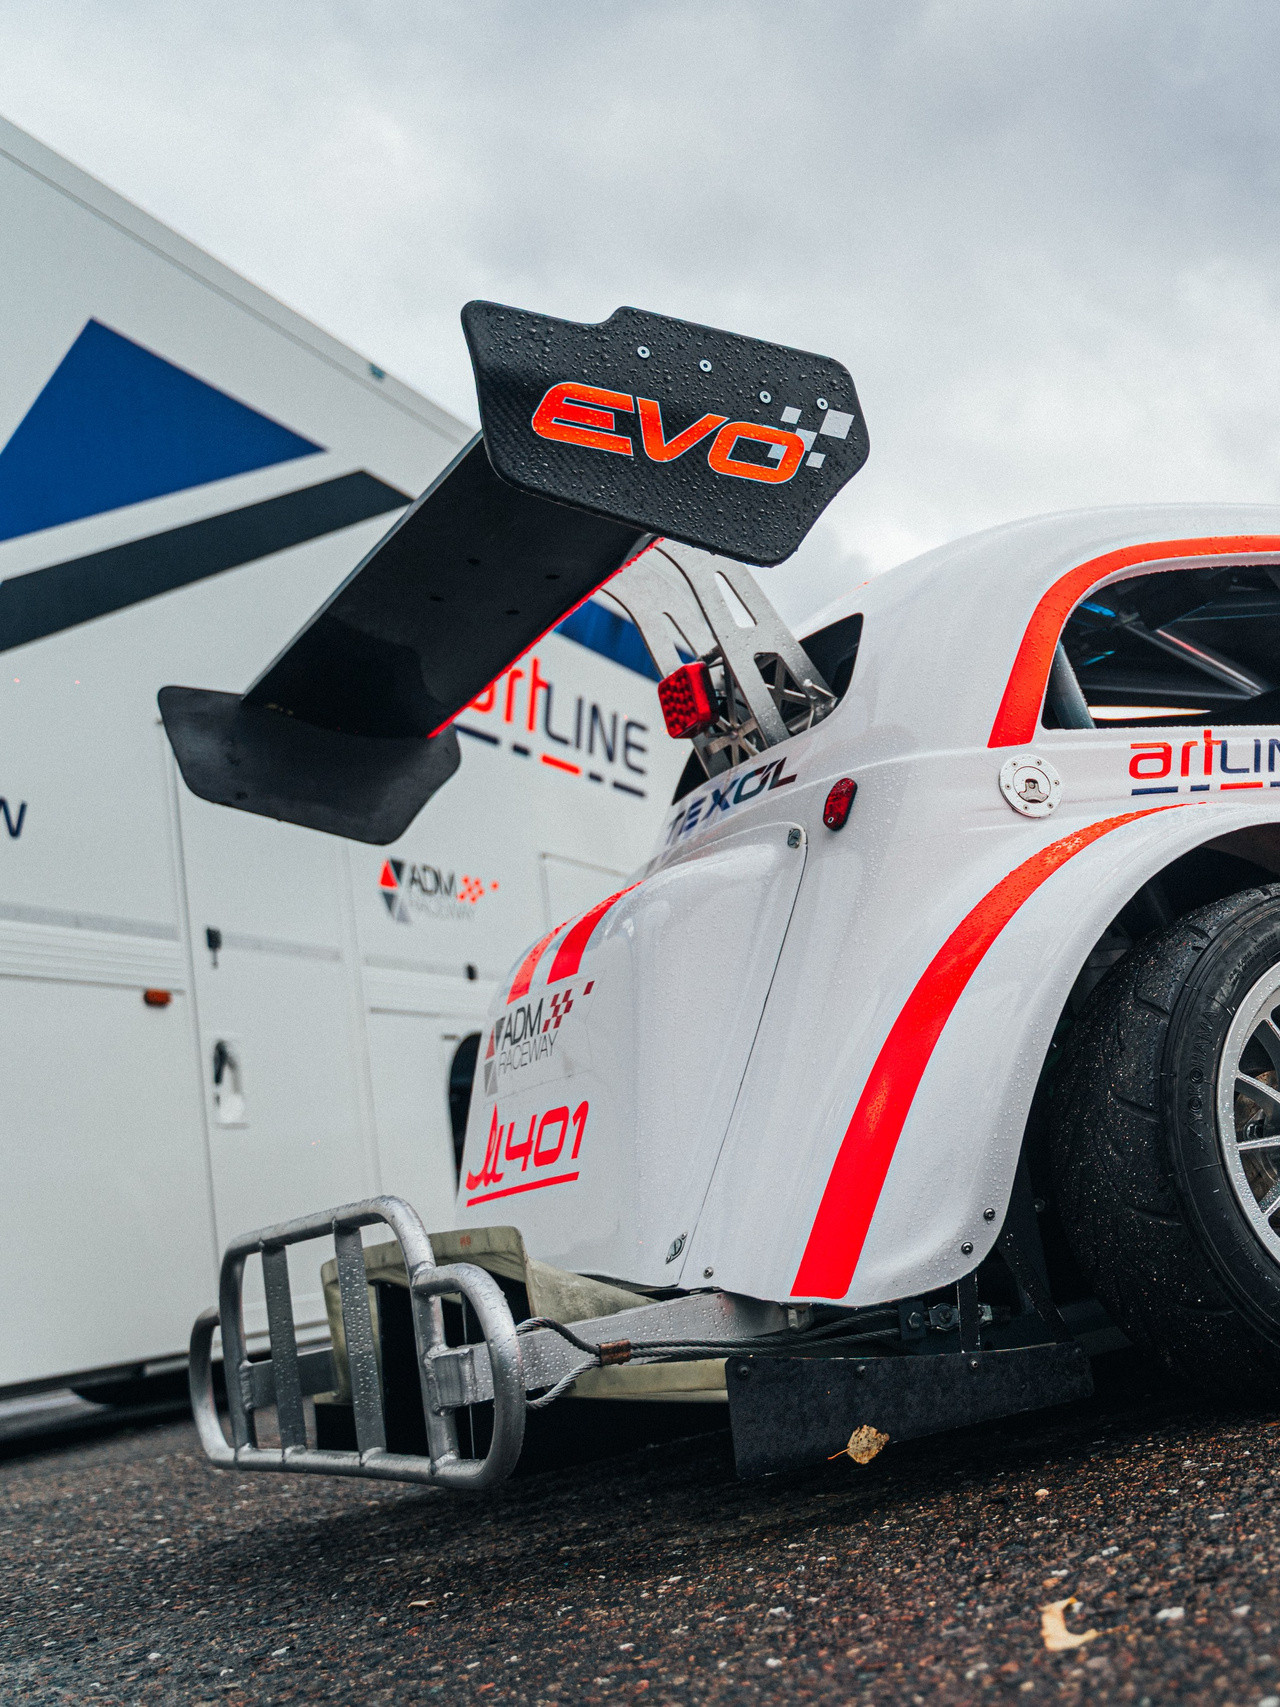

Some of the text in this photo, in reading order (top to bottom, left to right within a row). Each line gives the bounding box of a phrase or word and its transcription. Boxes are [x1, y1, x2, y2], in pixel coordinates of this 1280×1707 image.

[532, 381, 805, 485] EVO
[498, 1030, 559, 1076] RACEWAY
[501, 997, 544, 1050] ADM
[1187, 1000, 1218, 1125] YOKOHAMA
